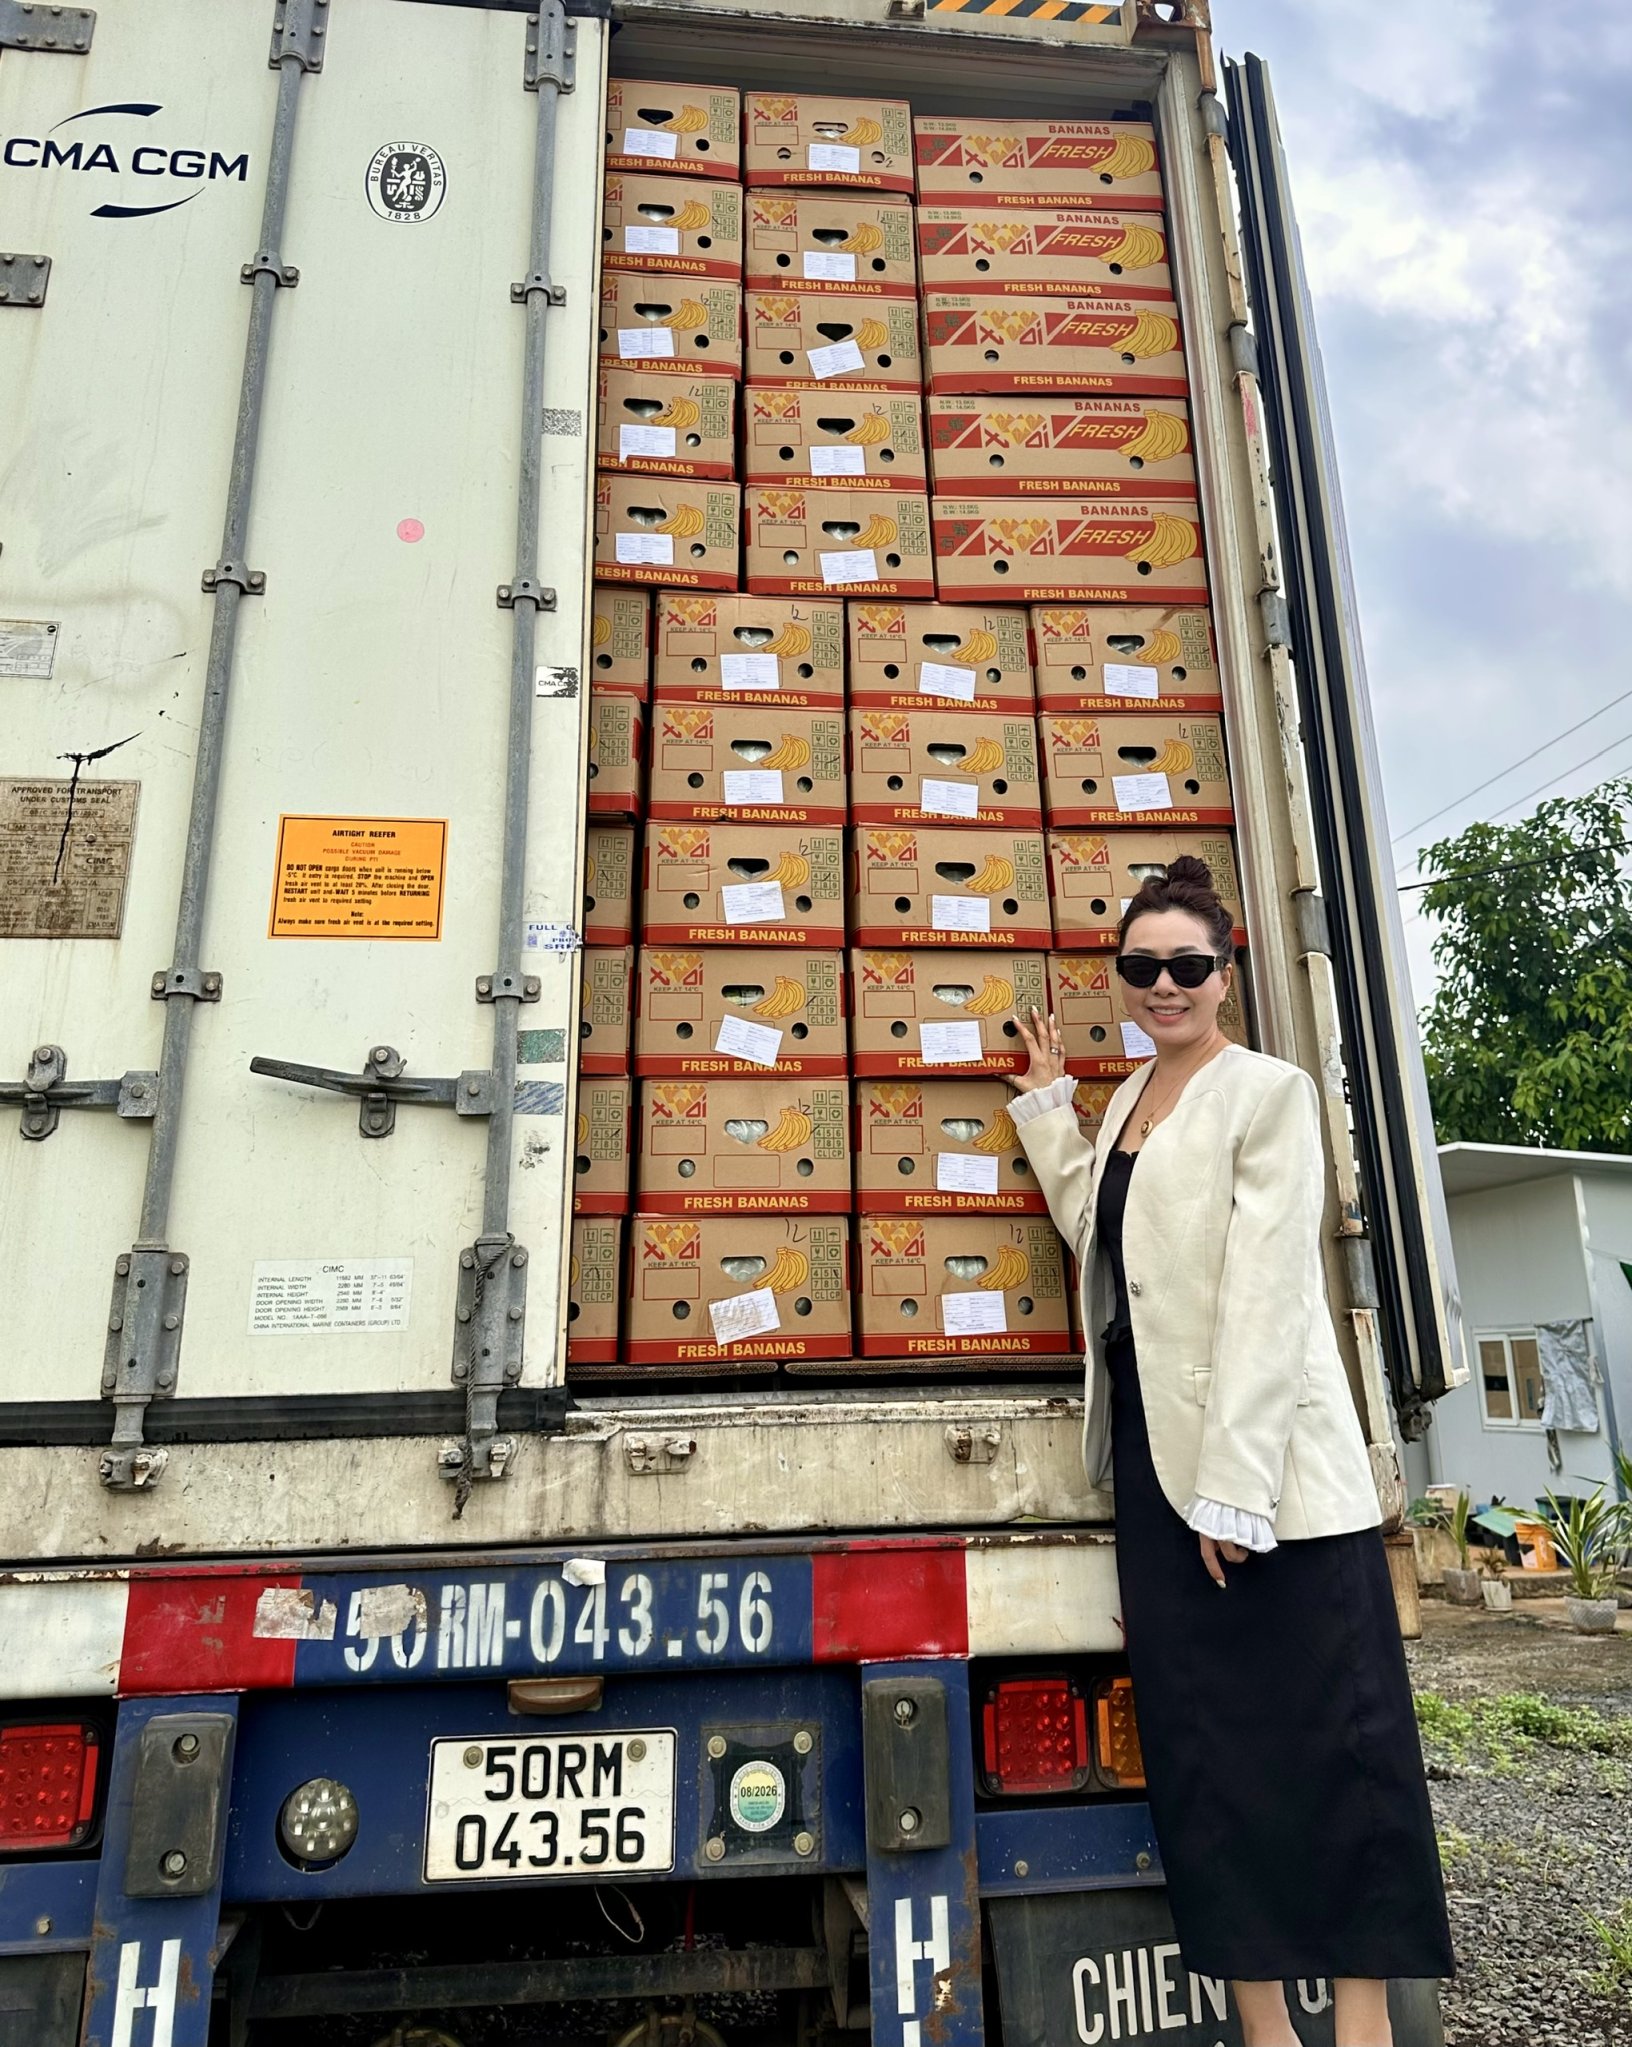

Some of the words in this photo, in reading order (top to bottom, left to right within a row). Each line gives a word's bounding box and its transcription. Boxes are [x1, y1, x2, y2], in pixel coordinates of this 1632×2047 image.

[1049, 125, 1110, 136] BANANAS
[1044, 145, 1112, 159] FRESH
[4, 137, 119, 173] CMA
[131, 146, 249, 182] CGM
[370, 144, 405, 182] BUREAU
[412, 144, 442, 186] VERITAS
[647, 160, 704, 171] BANANAS
[784, 173, 822, 184] FRESH
[826, 174, 881, 184] BANANAS
[997, 196, 1034, 204] FRESH
[1038, 196, 1092, 207] BANANAS
[388, 211, 421, 220] 1828
[1057, 214, 1119, 224] BANANAS
[1052, 233, 1122, 248] FRESH
[647, 258, 706, 271] BANANAS
[782, 280, 821, 290] FRESH
[825, 283, 881, 293] BANANAS
[1004, 284, 1043, 292] FRESH
[1046, 284, 1102, 295] BANANAS
[1068, 301, 1131, 311] BANANAS
[1062, 322, 1134, 336] FRESH
[643, 362, 702, 373] BANANAS
[1014, 376, 1053, 384] FRESH
[1056, 376, 1113, 386] BANANAS
[1074, 402, 1140, 412] BANANAS
[1069, 424, 1143, 438] FRESH
[632, 461, 694, 473] BANANAS
[786, 478, 827, 487] FRESH
[831, 478, 891, 488] BANANAS
[1019, 481, 1059, 490] FRESH
[1063, 481, 1120, 491] BANANAS
[1082, 507, 1147, 515] BANANAS
[1075, 529, 1151, 544] FRESH
[635, 570, 698, 585] BANANAS
[790, 582, 832, 592] FRESH
[1024, 589, 1064, 600] FRESH
[1068, 590, 1127, 600] BANANAS
[697, 691, 740, 701] FRESH
[745, 693, 807, 705] BANANAS
[891, 696, 932, 706] FRESH
[1080, 698, 1121, 710] FRESH
[12, 786, 53, 794] APPROVED
[693, 807, 737, 820] FRESH
[742, 809, 807, 822] BANANAS
[1091, 811, 1129, 821] FRESH
[1134, 811, 1198, 822] BANANAS
[332, 830, 365, 838] AIRTIGHT
[689, 929, 735, 939] FRESH
[740, 930, 806, 942] BANANAS
[902, 932, 946, 941] FRESH
[951, 932, 1014, 943] BANANAS
[682, 1061, 728, 1071] FRESH
[685, 1197, 732, 1208] FRESH
[738, 1197, 808, 1208] BANANAS
[905, 1196, 951, 1206] FRESH
[957, 1196, 1024, 1207] BANANAS
[322, 1265, 344, 1273] CIMC
[678, 1345, 727, 1357] FRESH
[733, 1342, 805, 1355] BANANAS
[909, 1340, 956, 1351] FRESH
[962, 1339, 1029, 1350] BANANAS
[485, 1742, 622, 1801] 50RM
[740, 1786, 777, 1797] 08/2026
[455, 1806, 646, 1869] 043.56
[895, 1895, 949, 2016] H
[111, 1938, 181, 2047] H
